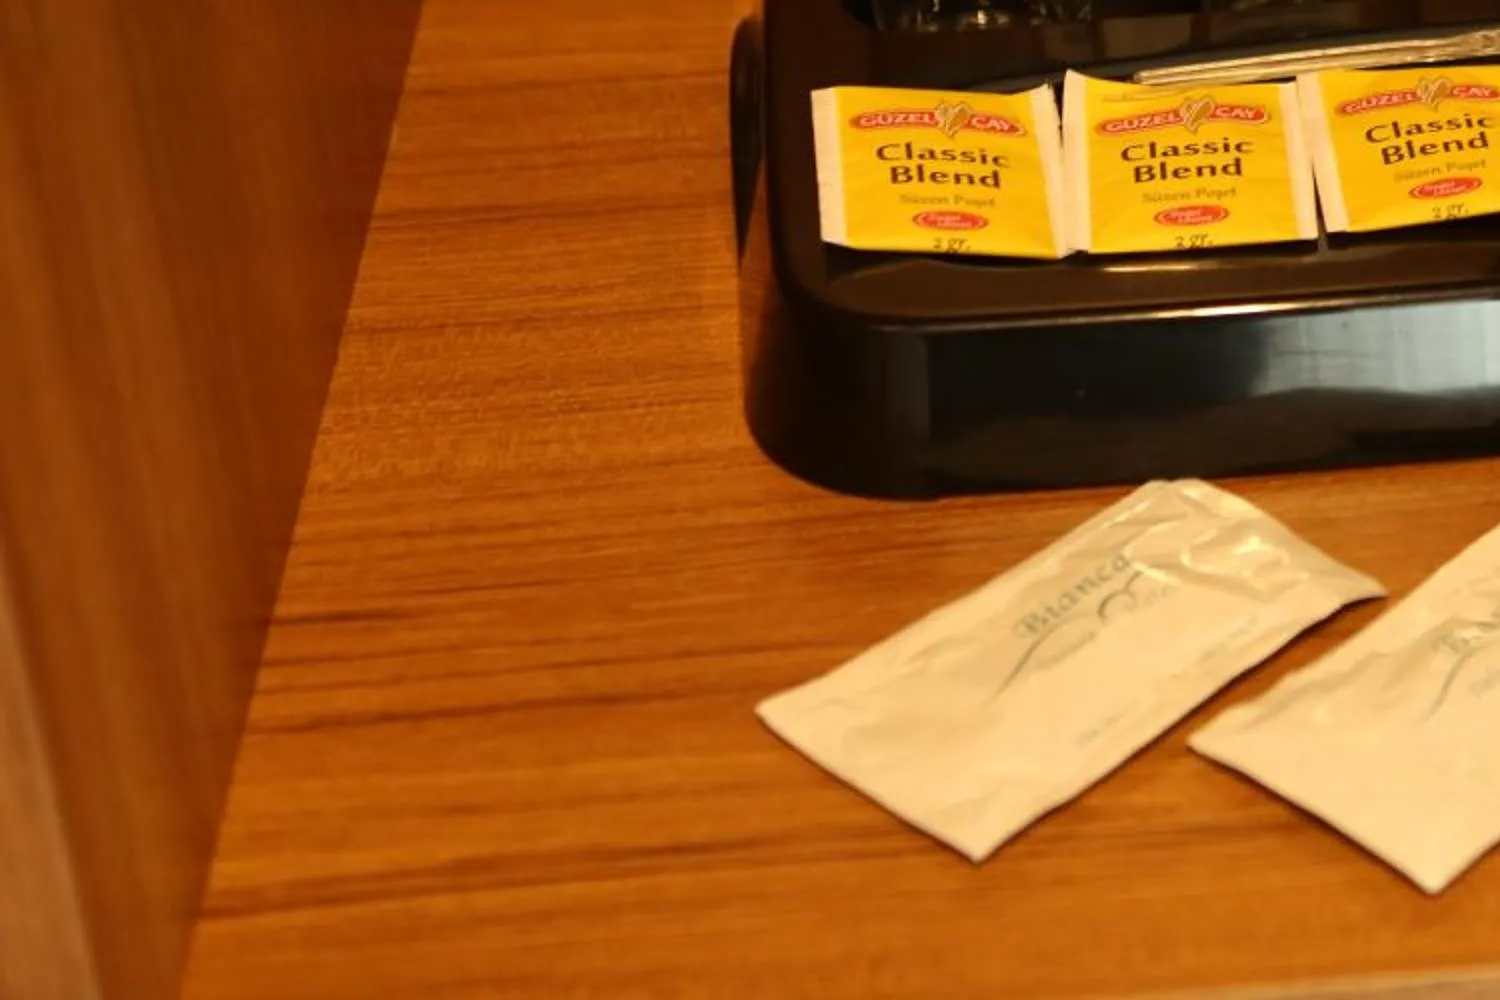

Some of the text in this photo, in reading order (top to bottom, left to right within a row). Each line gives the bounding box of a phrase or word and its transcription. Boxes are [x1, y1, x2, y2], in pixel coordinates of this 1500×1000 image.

[1365, 113, 1496, 144] Classic
[875, 141, 1011, 169] Classic
[1121, 137, 1255, 163] Classic
[1380, 131, 1490, 166] Blend
[890, 164, 1002, 189] Blend
[1133, 158, 1243, 184] Blend
[1012, 553, 1131, 639] Bianca
